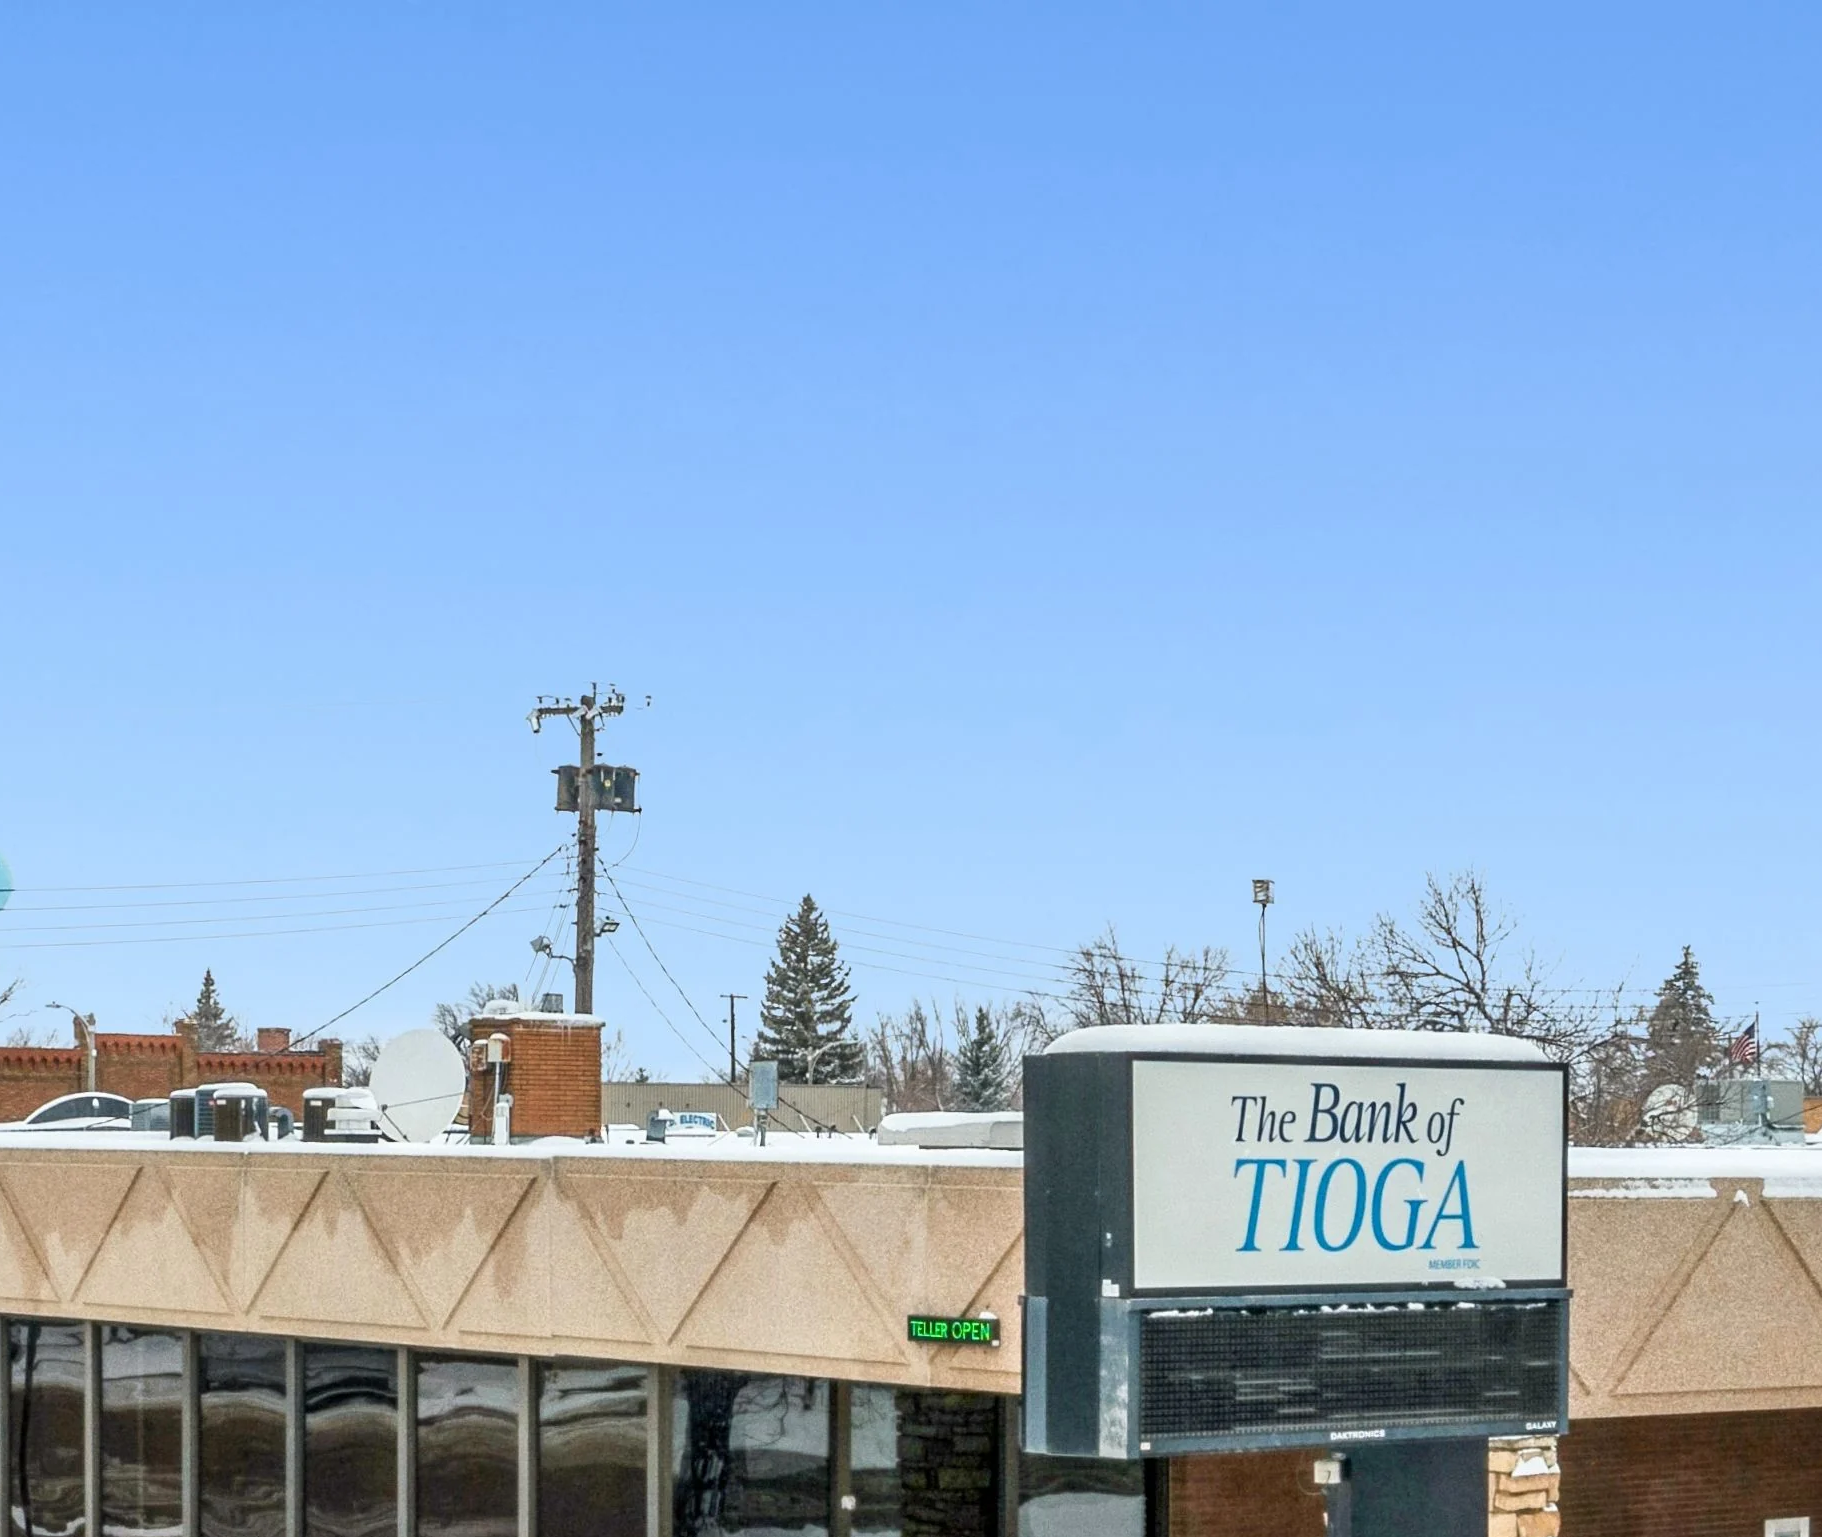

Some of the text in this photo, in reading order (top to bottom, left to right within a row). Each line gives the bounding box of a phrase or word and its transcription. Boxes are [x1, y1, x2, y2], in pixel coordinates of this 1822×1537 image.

[1230, 1082, 1465, 1156] The Bank of
[1234, 1158, 1480, 1252] TIOGA
[910, 1321, 990, 1340] TELLER OPEN
[1330, 1429, 1386, 1441] DAKTRONICS
[1525, 1421, 1556, 1430] GALAXY
